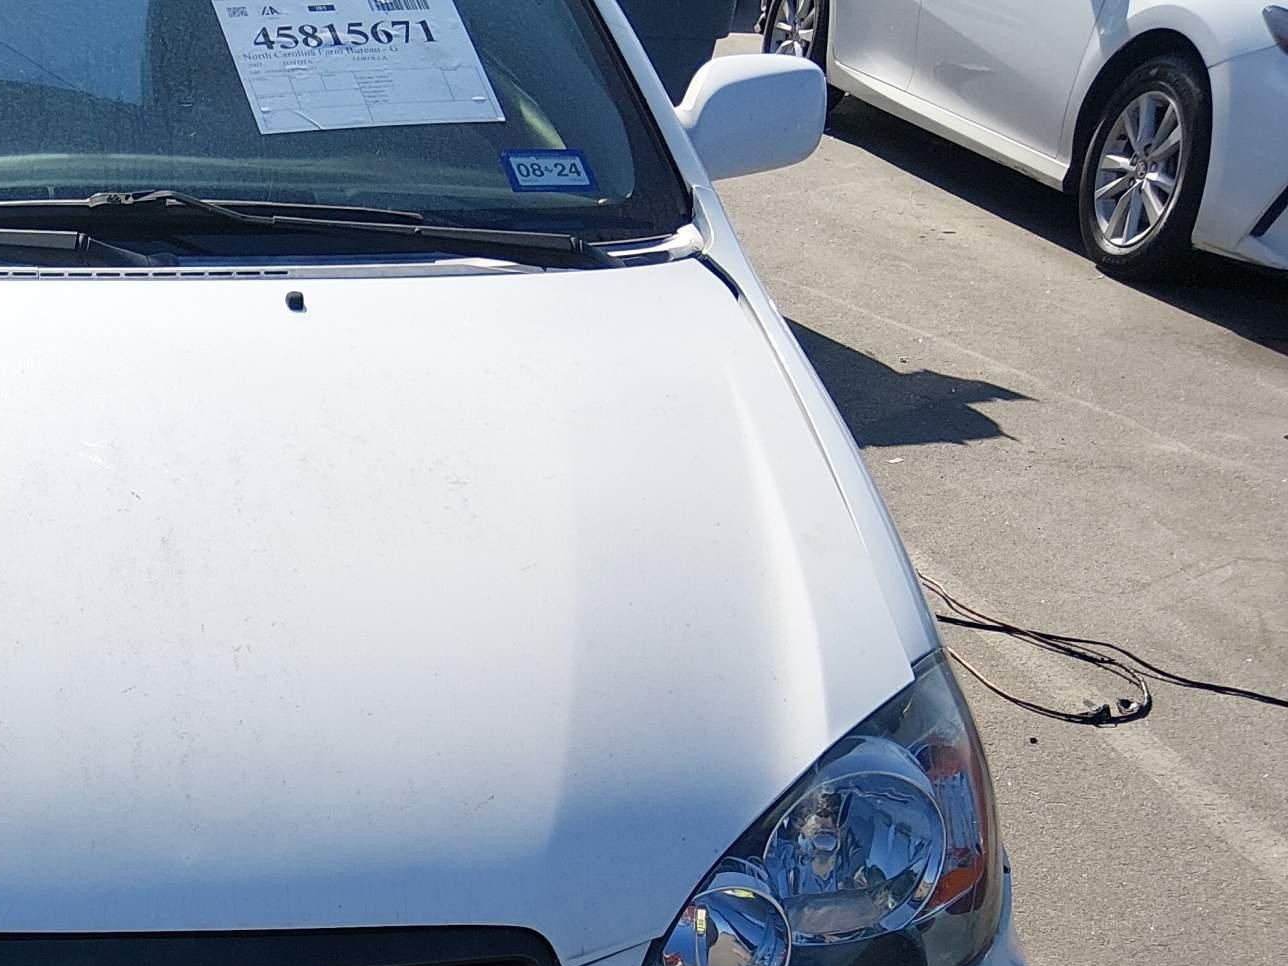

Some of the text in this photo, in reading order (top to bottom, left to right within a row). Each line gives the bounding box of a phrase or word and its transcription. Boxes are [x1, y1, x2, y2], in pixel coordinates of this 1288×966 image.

[253, 19, 437, 49] 45815671
[242, 50, 272, 61] North
[273, 48, 316, 60] Carolina
[345, 46, 381, 55] Bureau
